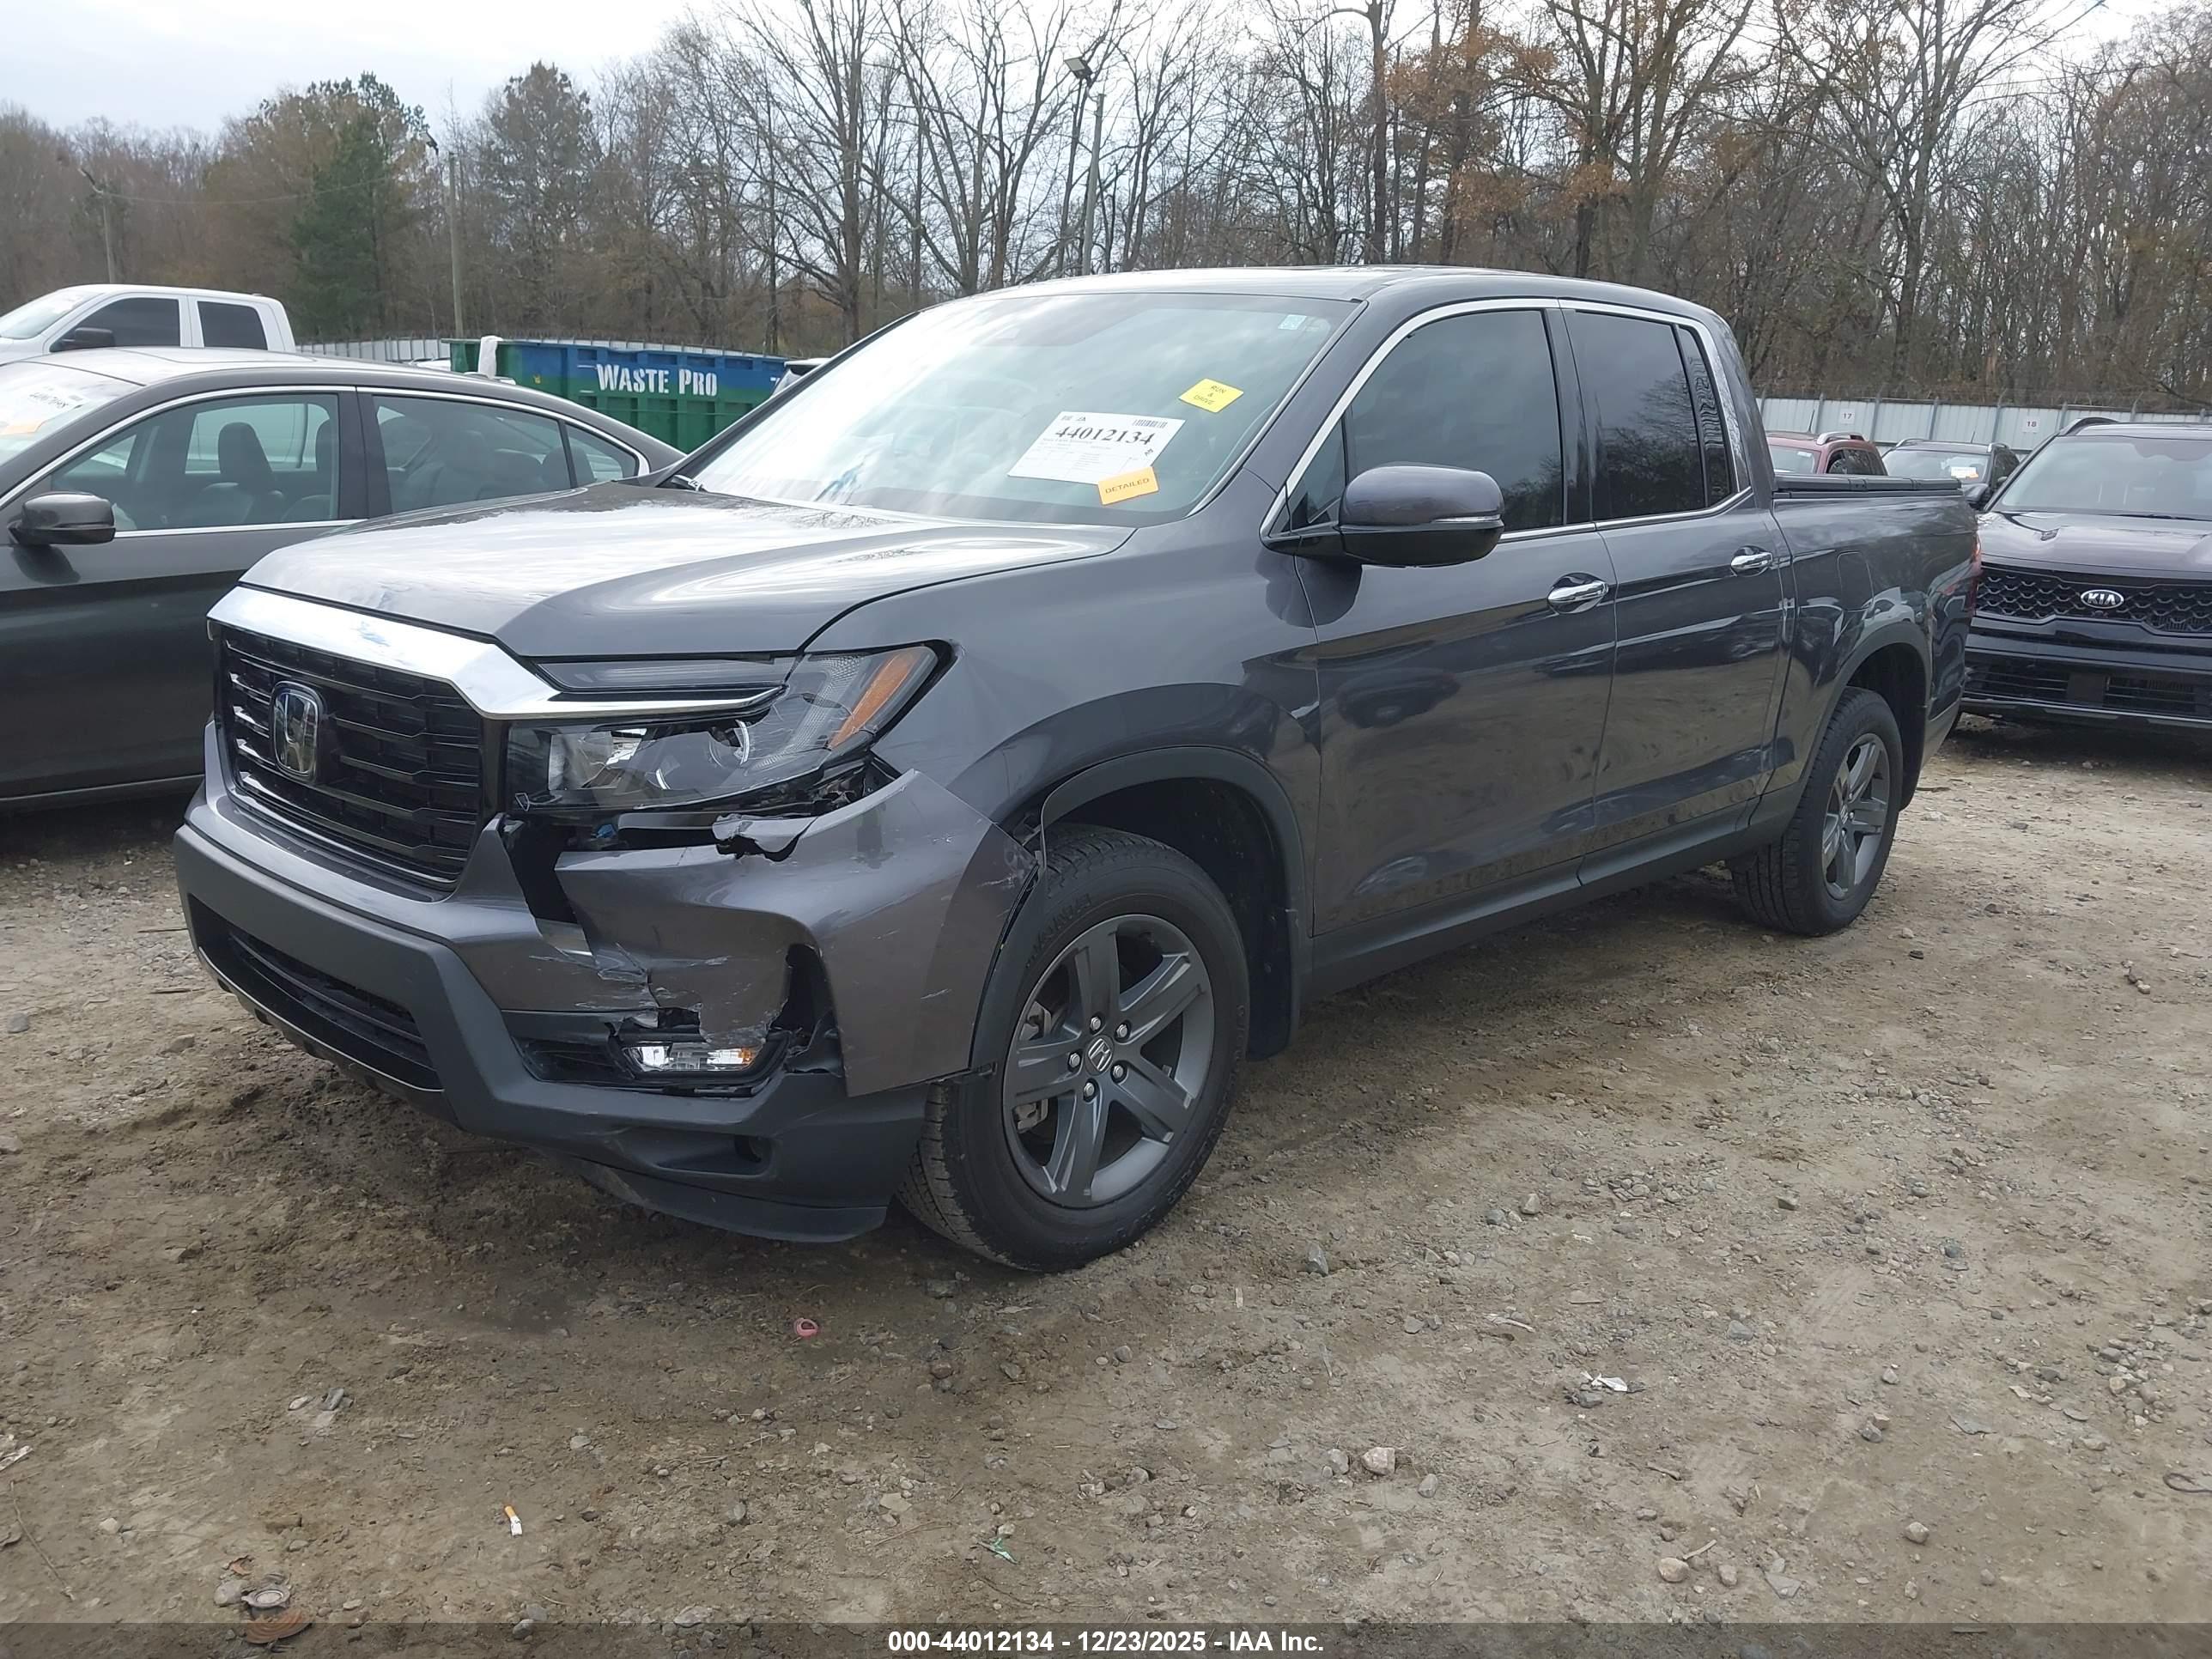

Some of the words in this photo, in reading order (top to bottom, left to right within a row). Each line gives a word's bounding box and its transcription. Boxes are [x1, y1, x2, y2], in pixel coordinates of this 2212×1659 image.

[596, 363, 670, 393] WASTE
[678, 368, 718, 397] PRO
[1054, 426, 1156, 446] 44012134
[1105, 477, 1150, 494] DETAILED
[2087, 592, 2116, 605] KIA
